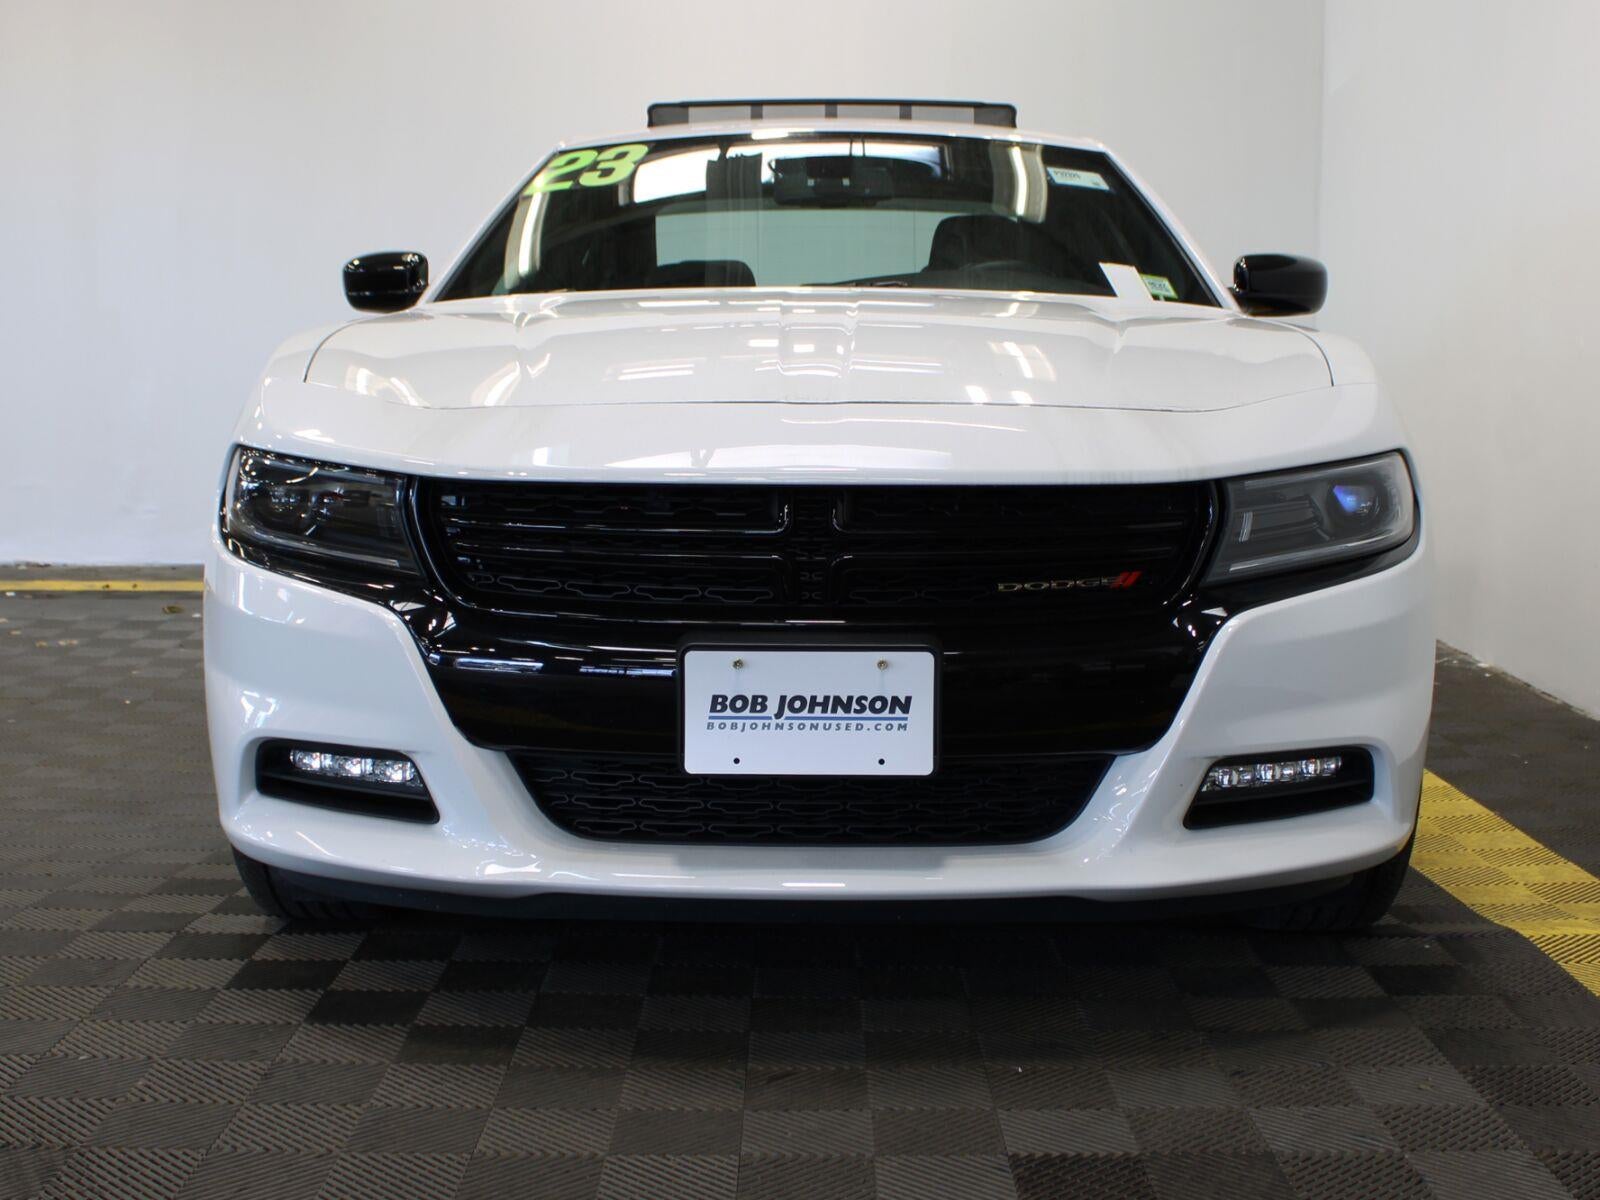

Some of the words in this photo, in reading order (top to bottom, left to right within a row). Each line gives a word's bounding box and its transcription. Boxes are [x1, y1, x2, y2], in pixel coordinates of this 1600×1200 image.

[522, 143, 649, 196] 23
[998, 577, 1118, 592] DODGE
[709, 694, 768, 714] BOB
[774, 694, 913, 720] JOHNSON
[706, 721, 909, 732] BOBJOHNSONUSED.COM
